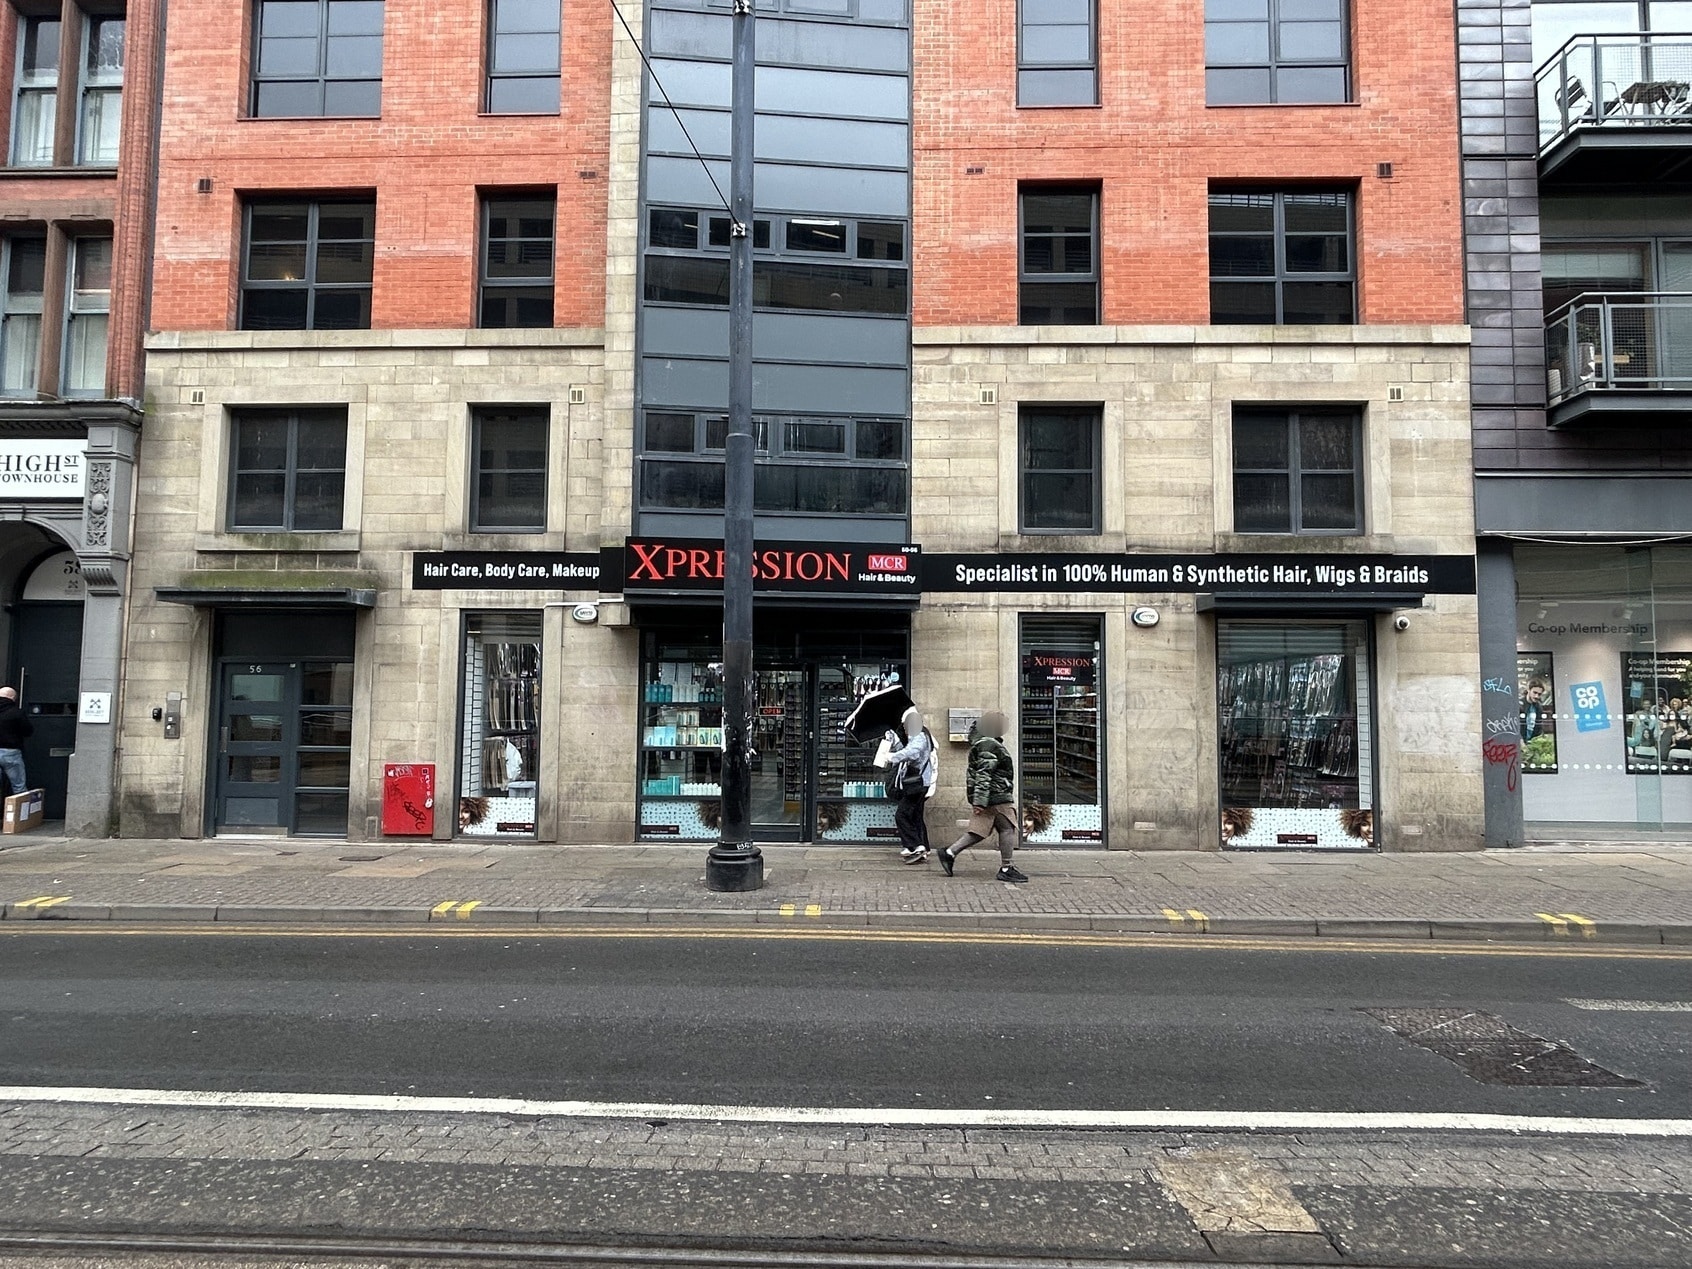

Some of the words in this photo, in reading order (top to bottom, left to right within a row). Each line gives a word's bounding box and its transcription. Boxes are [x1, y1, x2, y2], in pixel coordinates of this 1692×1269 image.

[64, 455, 79, 464] ST
[0, 474, 78, 483] OWNHOUSE
[871, 557, 904, 569] MCR
[423, 563, 449, 577] Hair
[451, 563, 483, 579] Care,
[485, 563, 515, 579] Body
[518, 564, 550, 579] Care,
[552, 564, 600, 580] Makeup
[955, 564, 1037, 584] Specialist
[1042, 565, 1057, 582] in
[1063, 565, 1107, 582] 100%
[1111, 565, 1168, 582] Human
[1172, 565, 1184, 583] &
[1187, 565, 1269, 585] Synthetic
[1273, 565, 1312, 585] Hair,
[1315, 565, 1356, 586] Wigs
[1360, 566, 1371, 583] &
[1374, 566, 1429, 583] Braids
[858, 573, 877, 582] Hair
[877, 573, 883, 582] &
[885, 573, 916, 584] Beauty
[1528, 622, 1566, 635] Co-op
[1569, 622, 1648, 635] Membership
[1034, 657, 1090, 666] XPRESSION
[250, 665, 262, 673] 56
